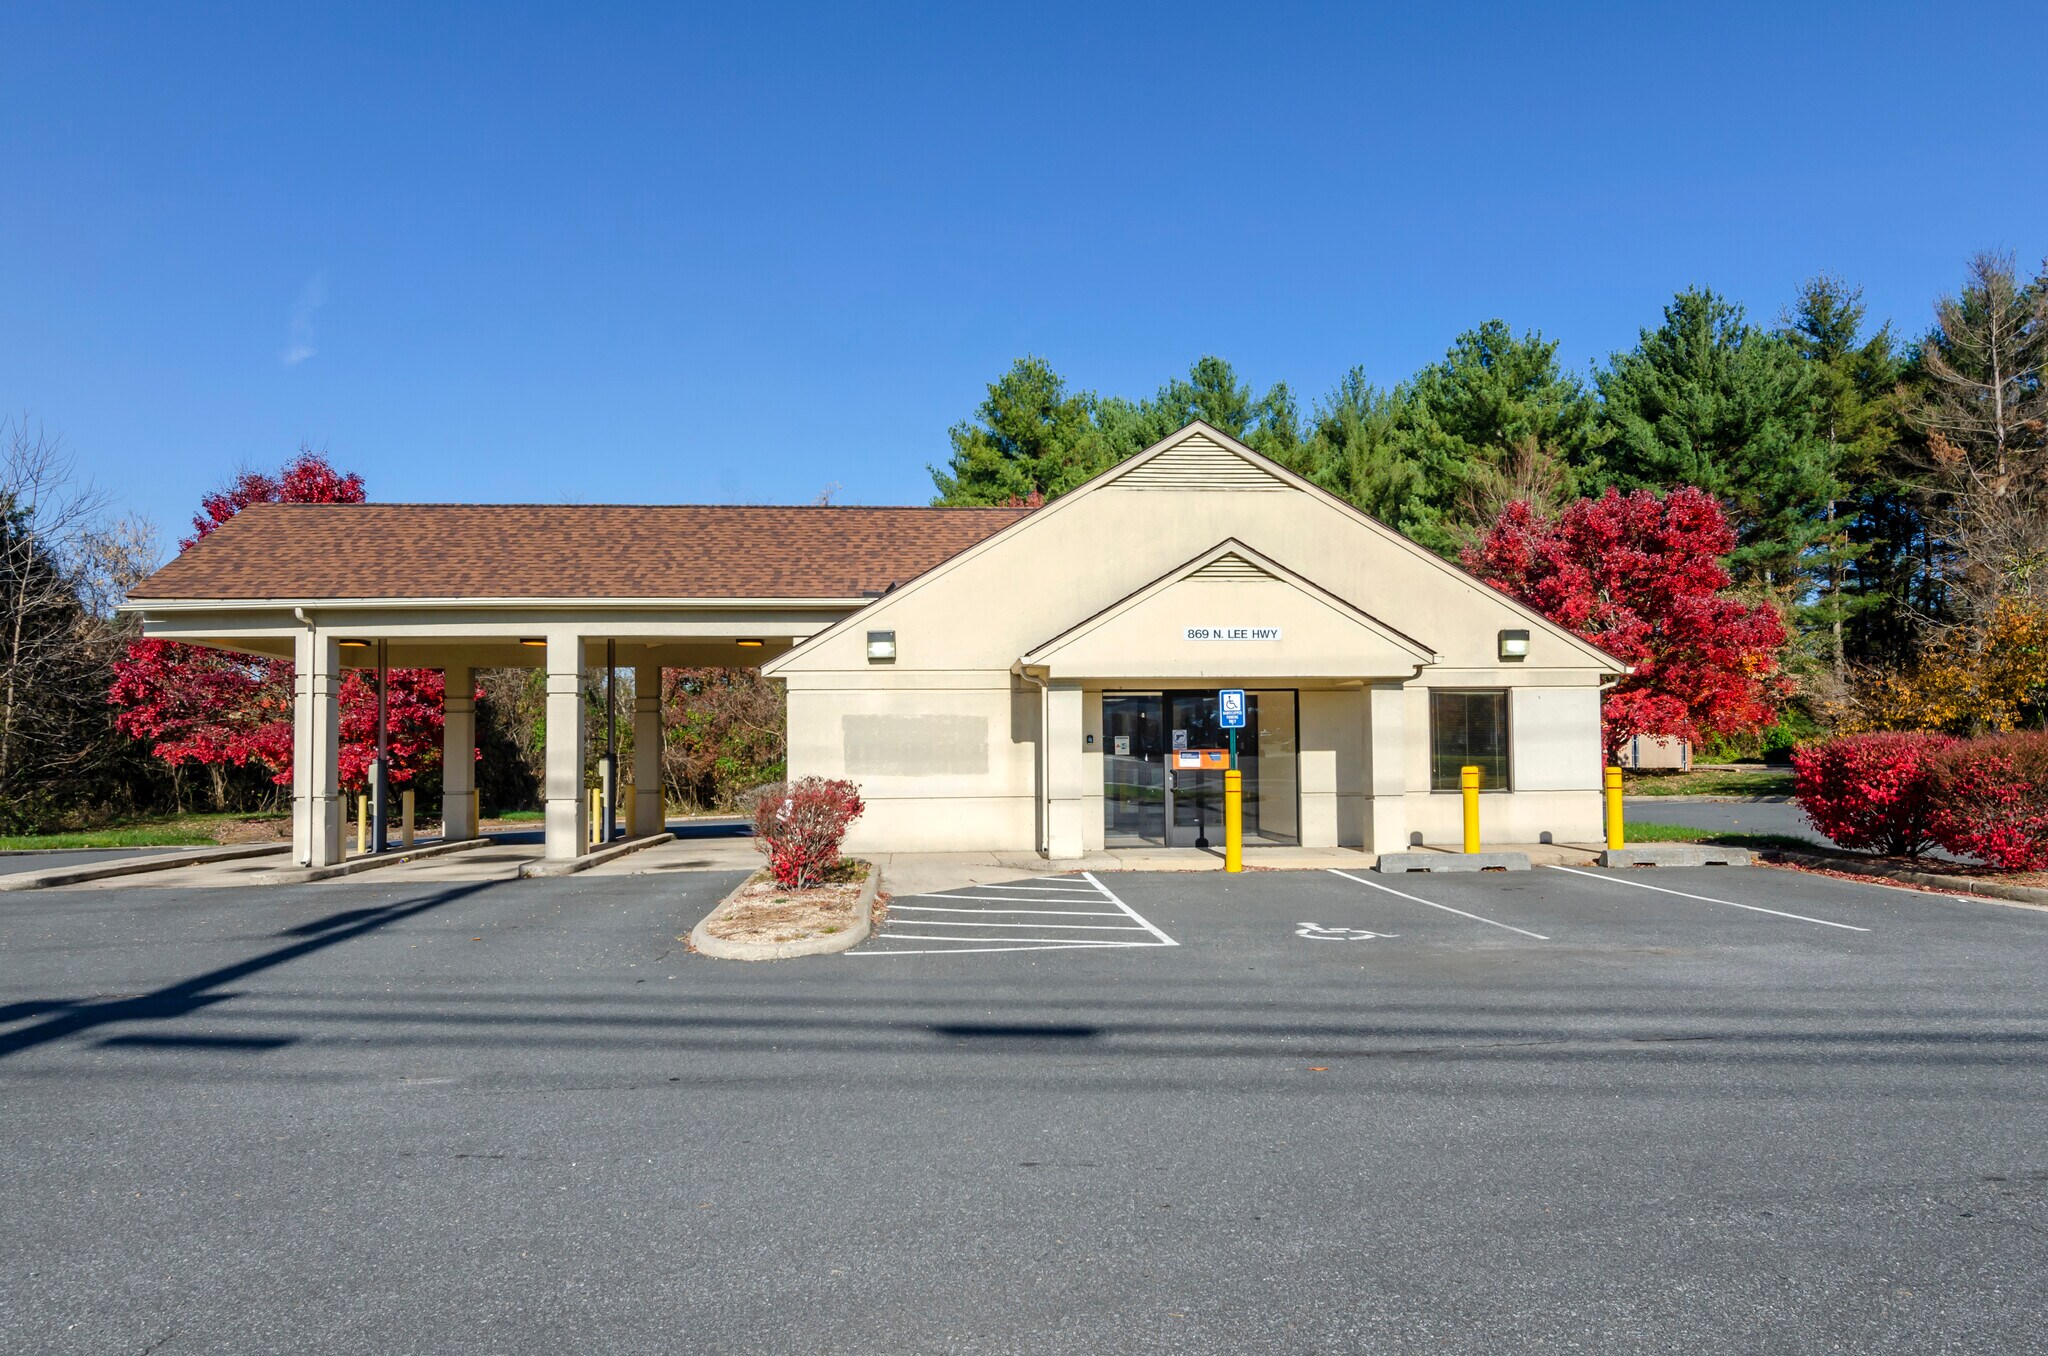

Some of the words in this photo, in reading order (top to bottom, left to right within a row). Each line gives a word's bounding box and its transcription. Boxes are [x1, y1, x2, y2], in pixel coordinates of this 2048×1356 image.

[1187, 629, 1209, 639] 869
[1213, 629, 1223, 639] N.
[1227, 629, 1248, 639] LEE
[1252, 629, 1278, 639] HWY
